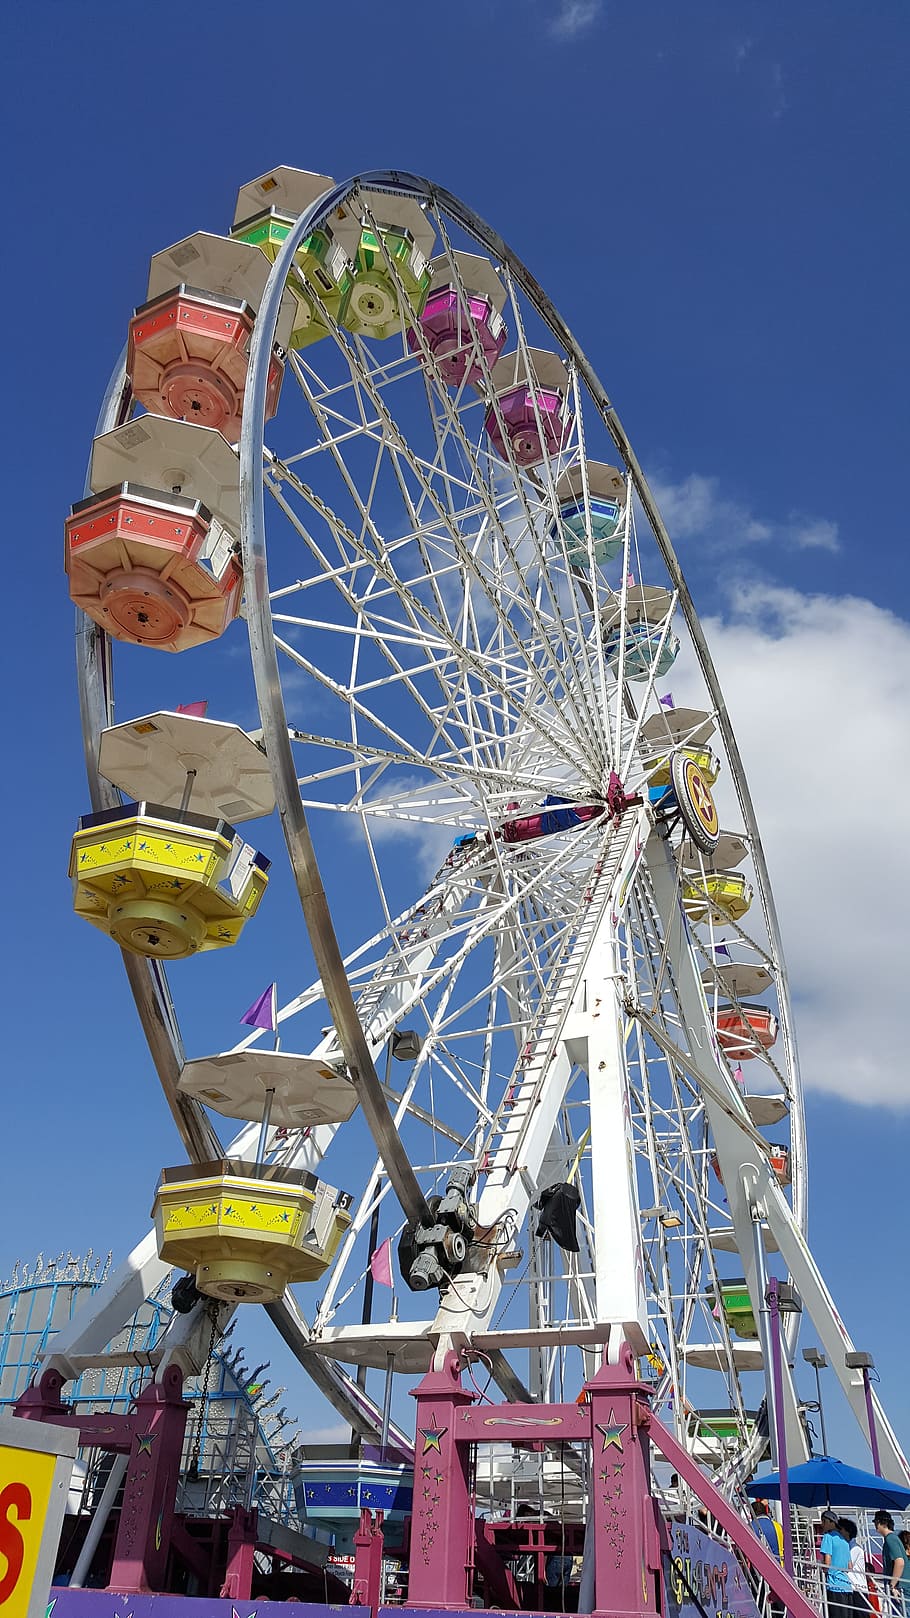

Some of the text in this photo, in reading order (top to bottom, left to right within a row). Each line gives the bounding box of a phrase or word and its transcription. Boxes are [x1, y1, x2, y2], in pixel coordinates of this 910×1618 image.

[276, 346, 284, 357] 8
[340, 1194, 349, 1208] 5
[670, 1556, 729, 1606] GIANT
